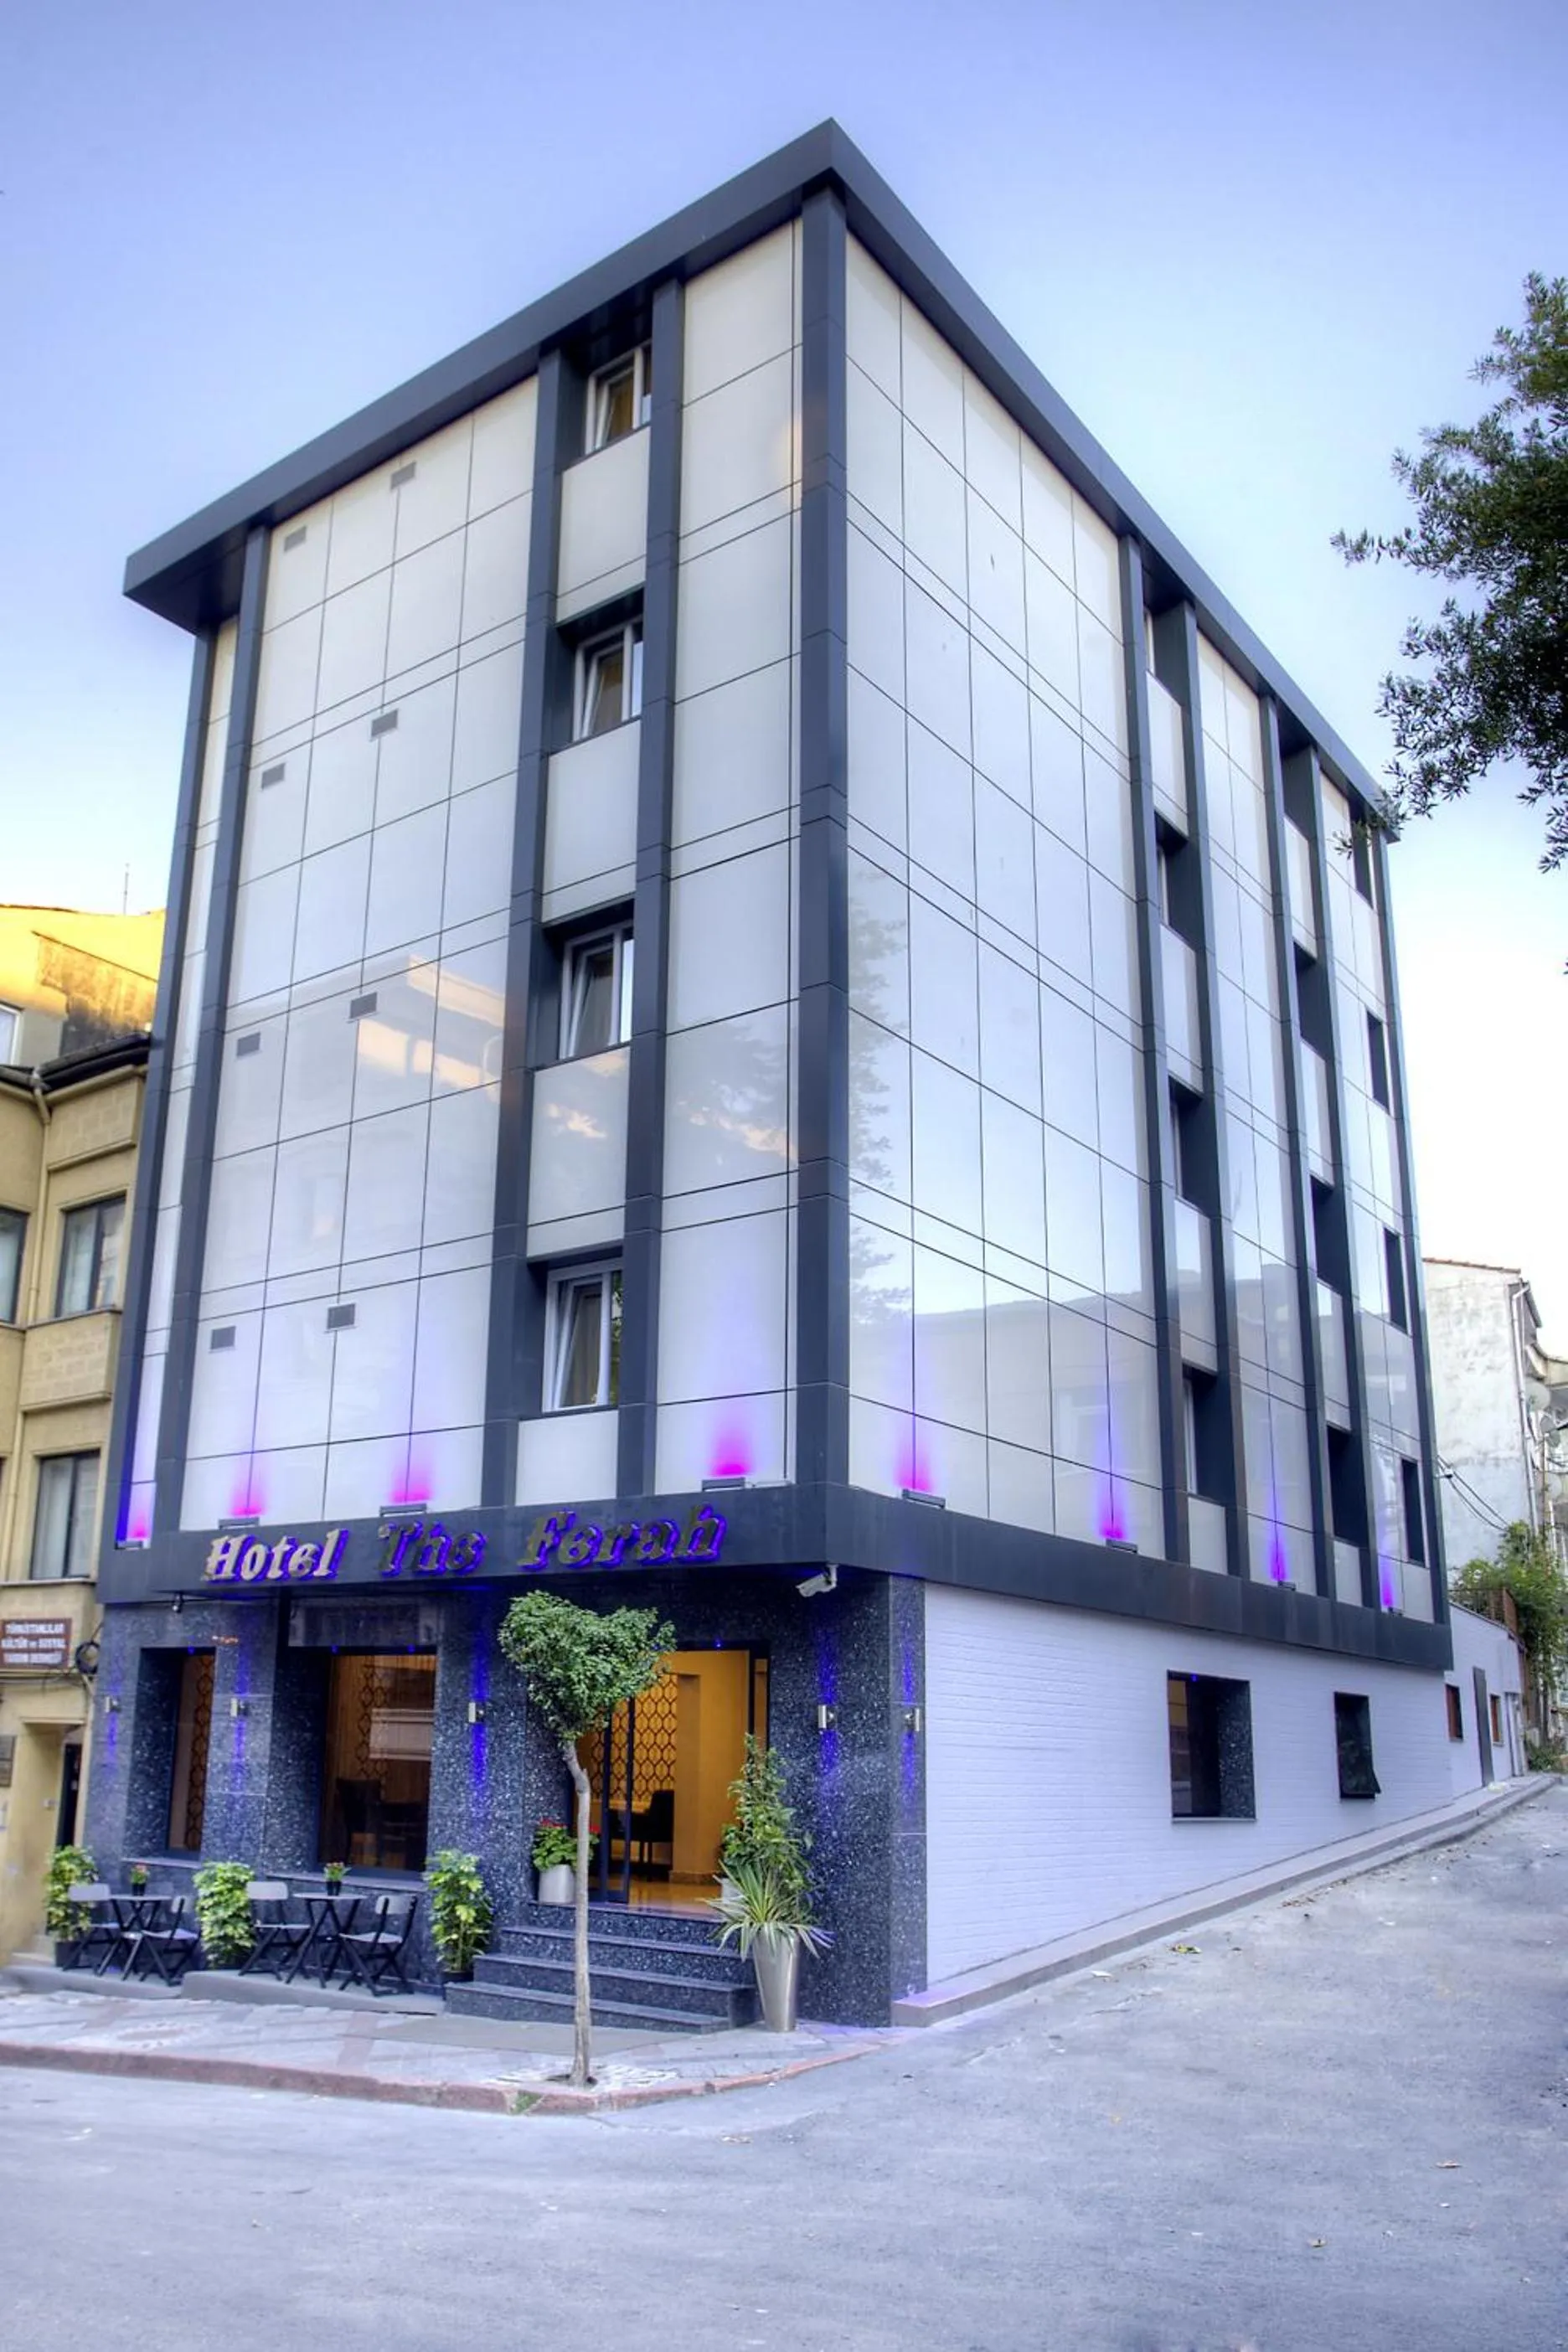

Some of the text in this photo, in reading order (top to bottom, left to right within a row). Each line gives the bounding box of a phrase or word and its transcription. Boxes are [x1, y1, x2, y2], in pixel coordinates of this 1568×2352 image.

[200, 1504, 727, 1583] Hotel The Ferah
